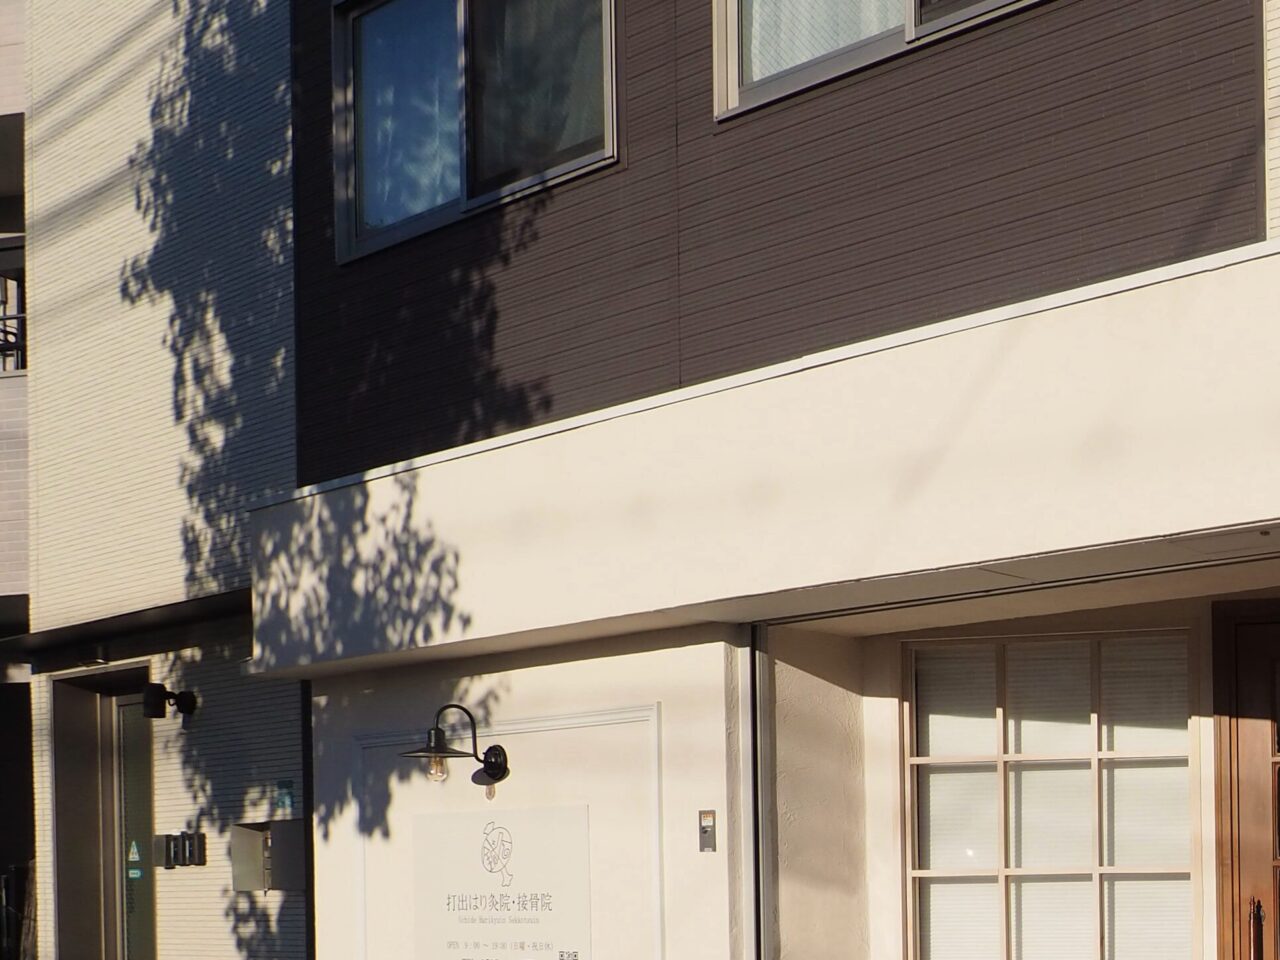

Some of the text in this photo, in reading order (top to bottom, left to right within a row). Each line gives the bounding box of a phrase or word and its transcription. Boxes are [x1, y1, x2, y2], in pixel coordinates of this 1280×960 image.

[446, 892, 553, 912] 打出はり灸院・接骨院
